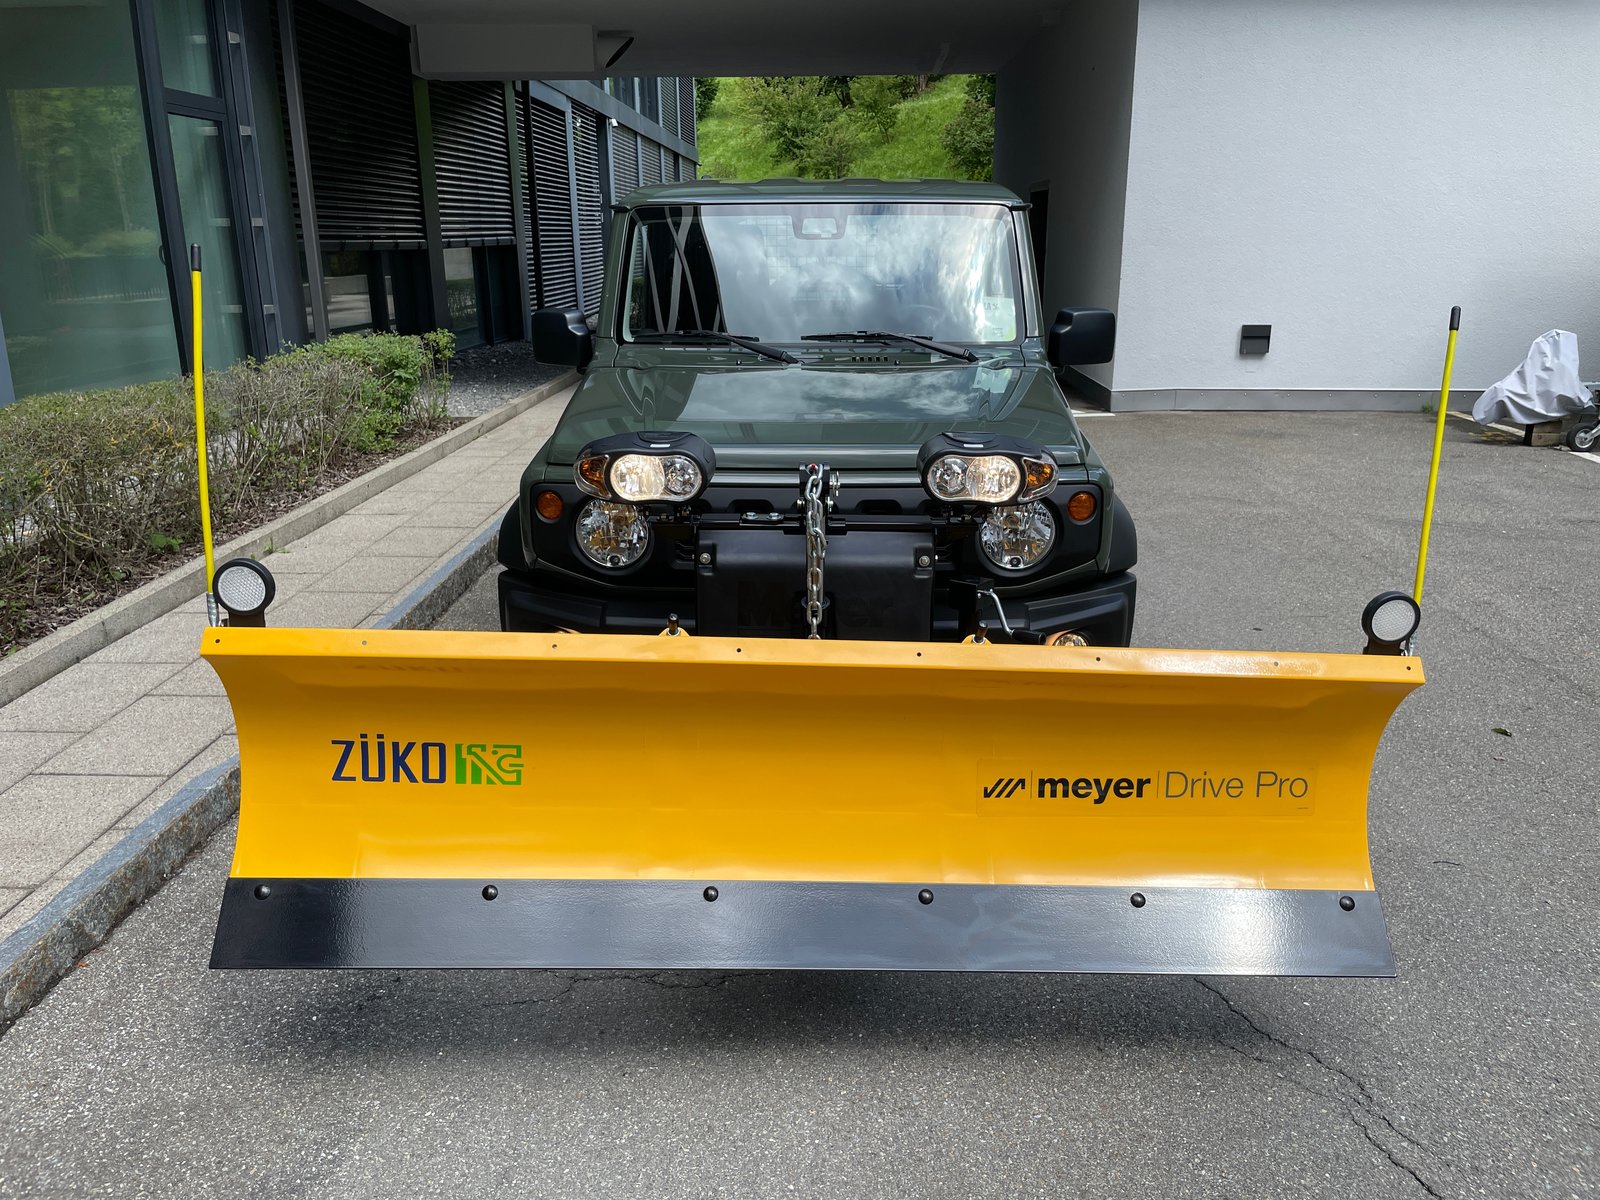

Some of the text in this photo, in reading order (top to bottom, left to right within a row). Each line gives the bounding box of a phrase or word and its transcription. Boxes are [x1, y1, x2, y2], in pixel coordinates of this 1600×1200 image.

[330, 733, 447, 784] ZÜKO
[1037, 770, 1309, 805] meyer Drive Pro
